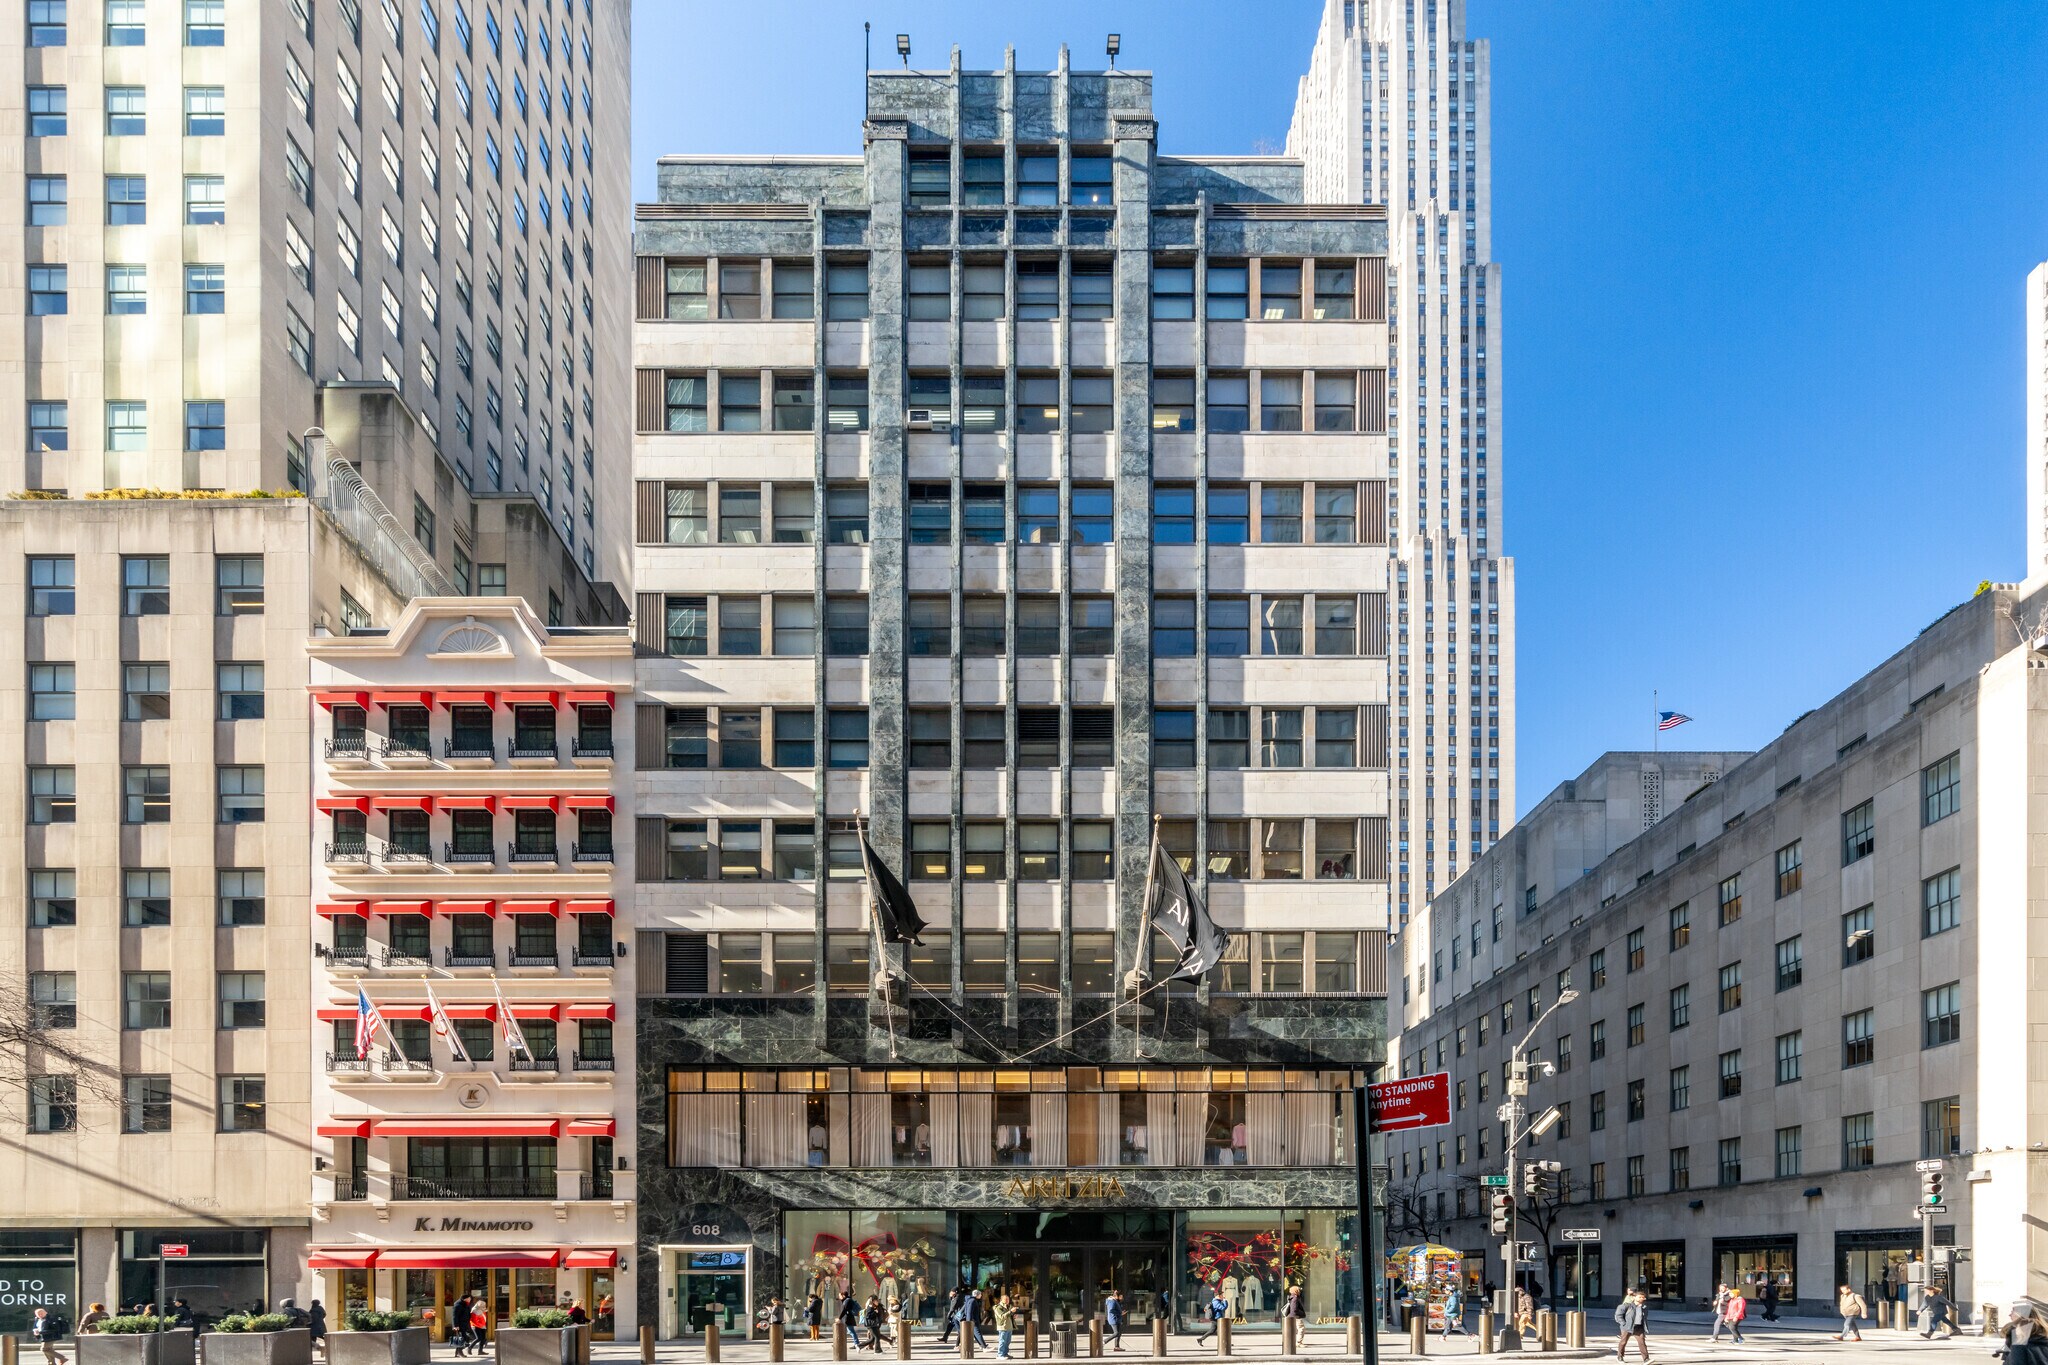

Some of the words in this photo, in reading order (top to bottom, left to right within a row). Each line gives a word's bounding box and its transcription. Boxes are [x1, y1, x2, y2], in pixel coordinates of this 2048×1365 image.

[467, 1089, 480, 1100] K
[1369, 1088, 1383, 1099] NO
[1385, 1080, 1435, 1097] STANDING
[1370, 1096, 1411, 1110] Anytime
[1008, 1176, 1126, 1198] ARITZIA
[414, 1217, 436, 1232] K.
[692, 1224, 720, 1236] 608
[17, 1279, 44, 1291] TO
[1316, 1316, 1348, 1325] ARITZI
